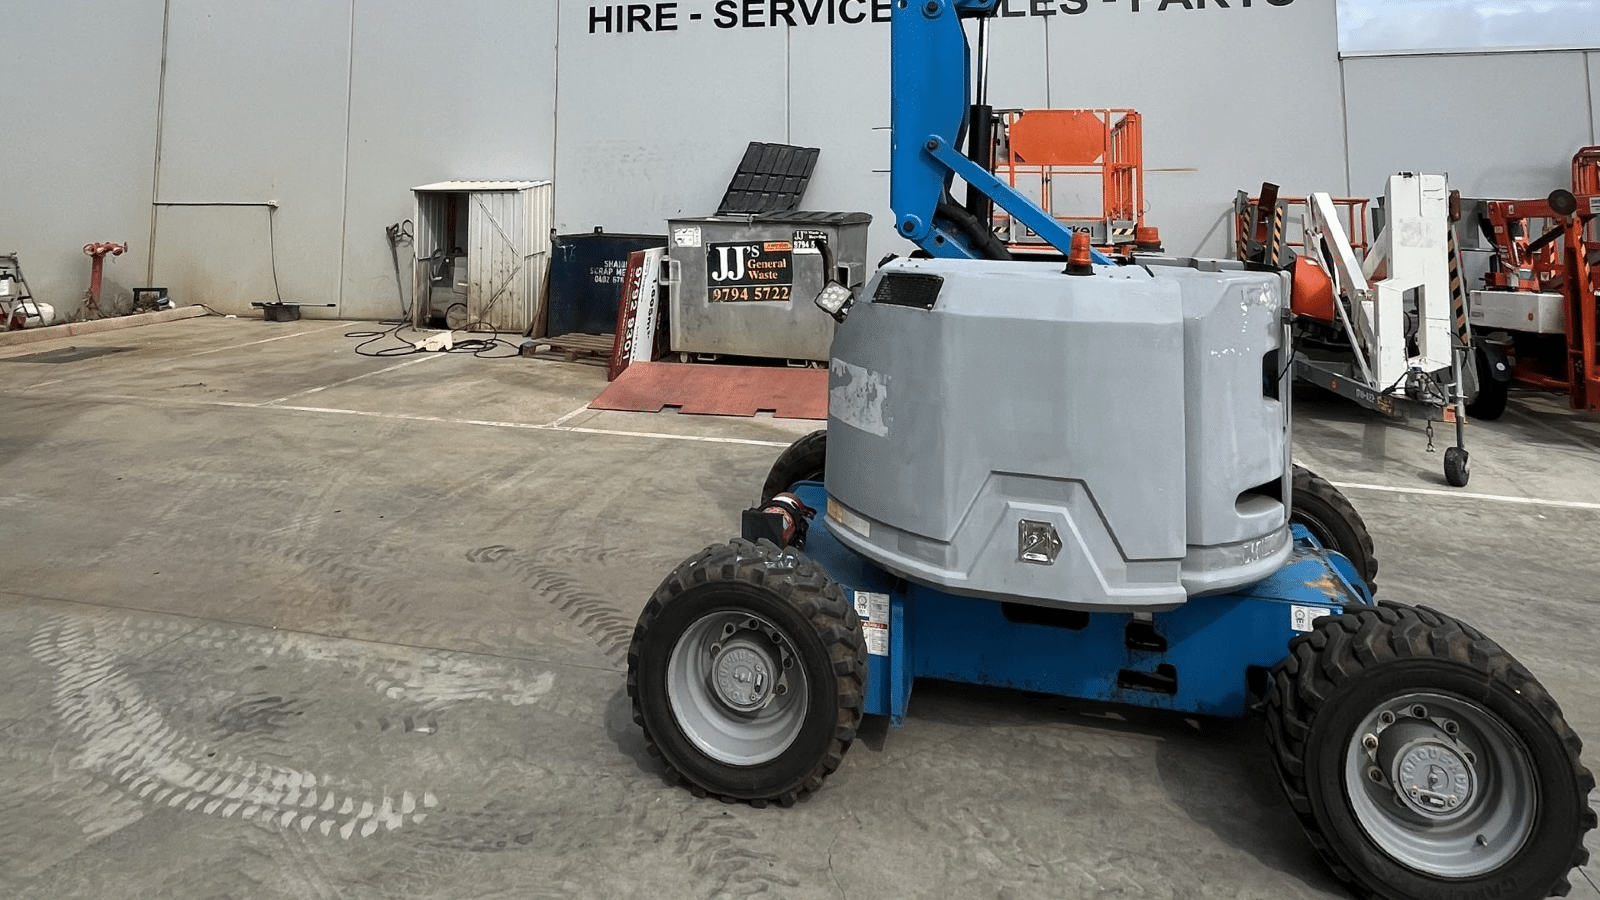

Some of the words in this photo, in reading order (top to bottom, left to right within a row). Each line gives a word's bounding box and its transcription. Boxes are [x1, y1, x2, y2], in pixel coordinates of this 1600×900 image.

[588, 3, 678, 34] HIRE
[713, 0, 892, 29] SERVICE
[991, 0, 1088, 18] LES
[747, 258, 787, 269] General
[590, 267, 614, 275] SCRAP
[748, 270, 778, 280] Waste
[713, 288, 748, 301] 9794
[754, 287, 789, 300] 5722
